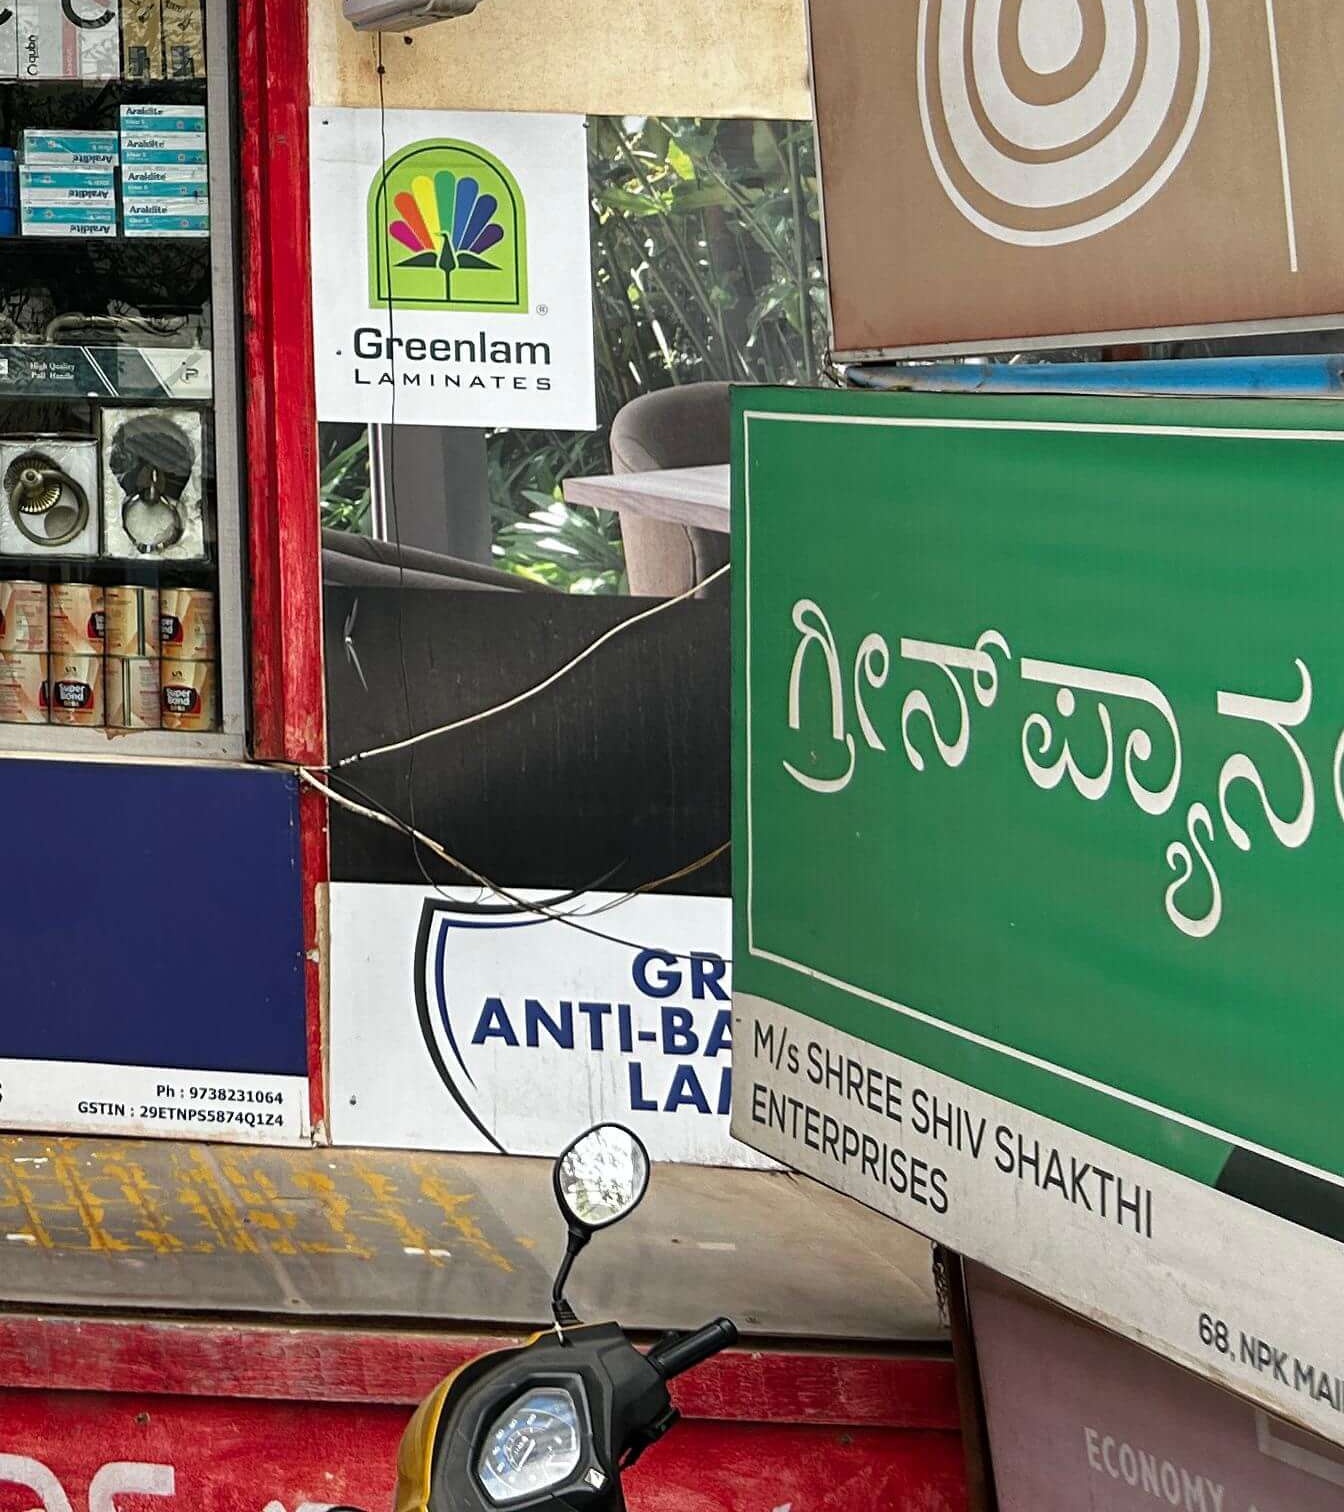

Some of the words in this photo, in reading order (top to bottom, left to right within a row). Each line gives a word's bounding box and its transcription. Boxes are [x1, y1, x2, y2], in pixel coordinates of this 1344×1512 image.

[353, 326, 551, 365] Greenlam
[354, 369, 551, 391] LAMINATES
[78, 1100, 126, 1117] GSTIN
[156, 1084, 176, 1099] Ph
[188, 1086, 284, 1105] 9738231064
[753, 1018, 801, 1076] M/s
[806, 1040, 903, 1124] SHREE
[910, 1087, 986, 1161] SHIV
[995, 1124, 1153, 1240] SHAKTHI
[751, 1083, 951, 1216] ENTERPRISES
[1239, 1330, 1292, 1387] NPK
